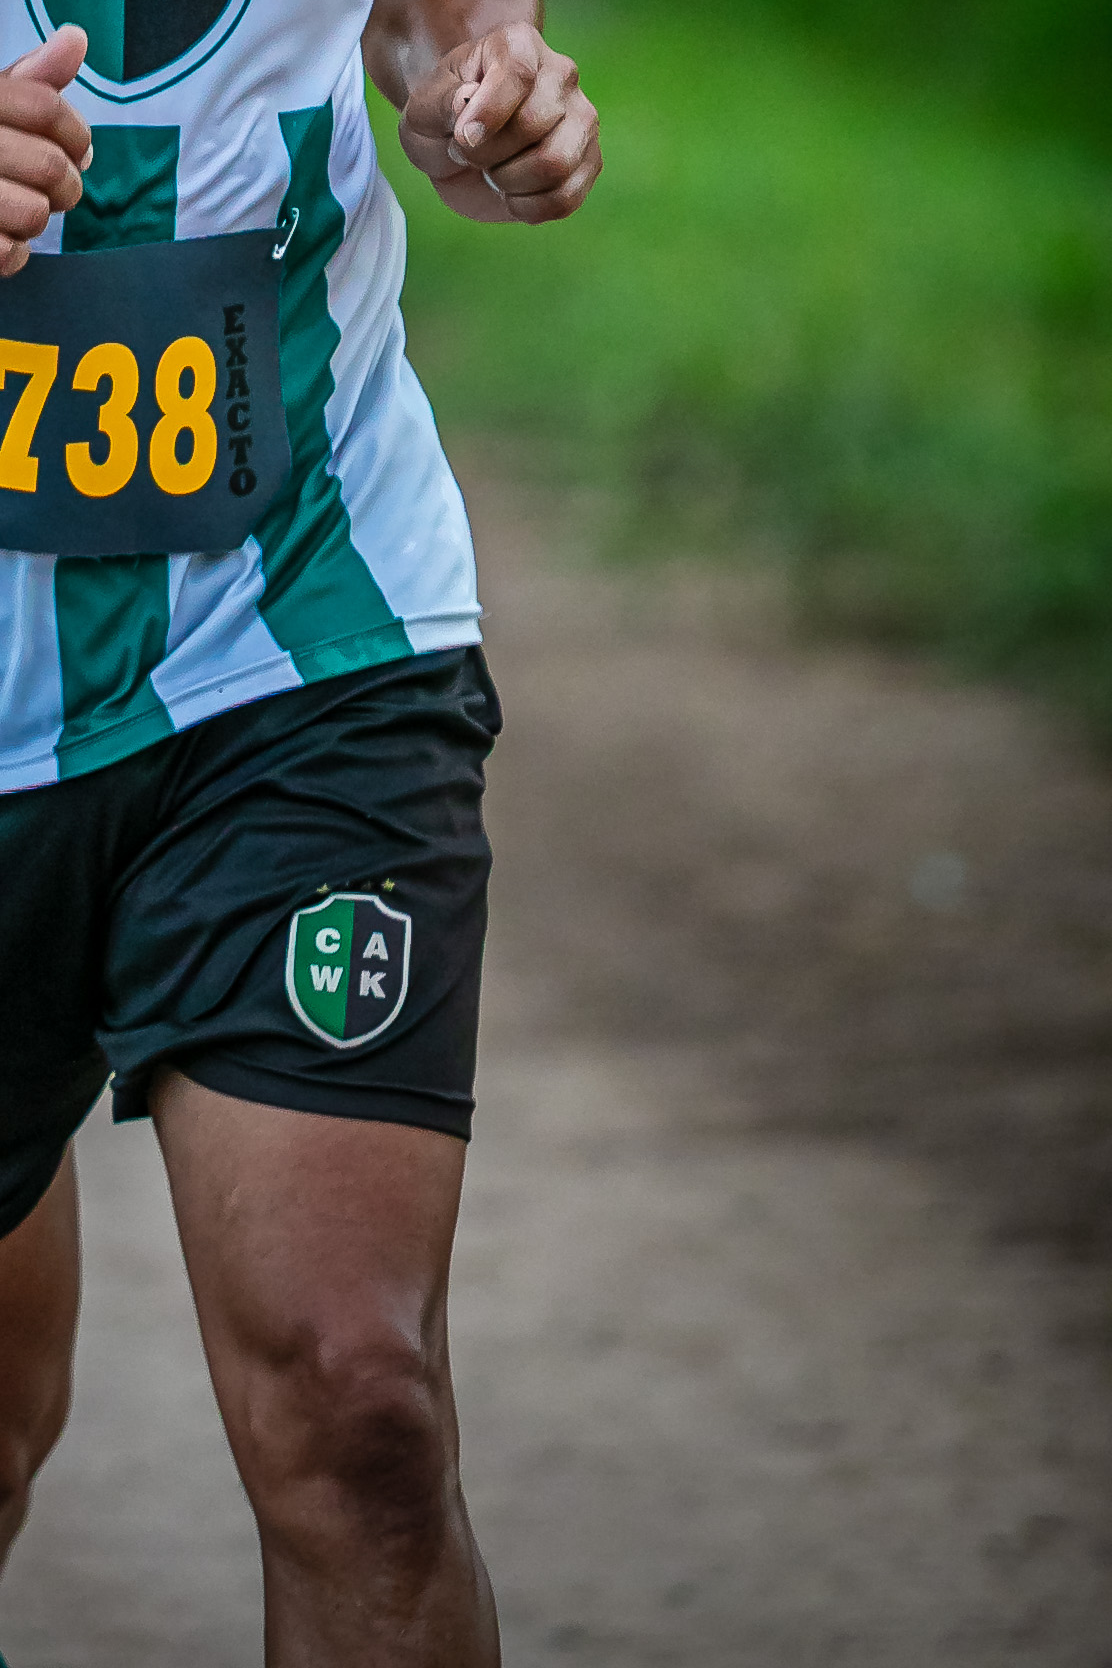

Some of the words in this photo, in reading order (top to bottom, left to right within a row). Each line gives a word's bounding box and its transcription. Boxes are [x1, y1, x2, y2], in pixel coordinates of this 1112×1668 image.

[222, 304, 257, 498] EXACTO
[315, 927, 342, 954] C
[362, 931, 388, 962] A
[310, 964, 344, 994] W
[359, 970, 386, 1000] K
